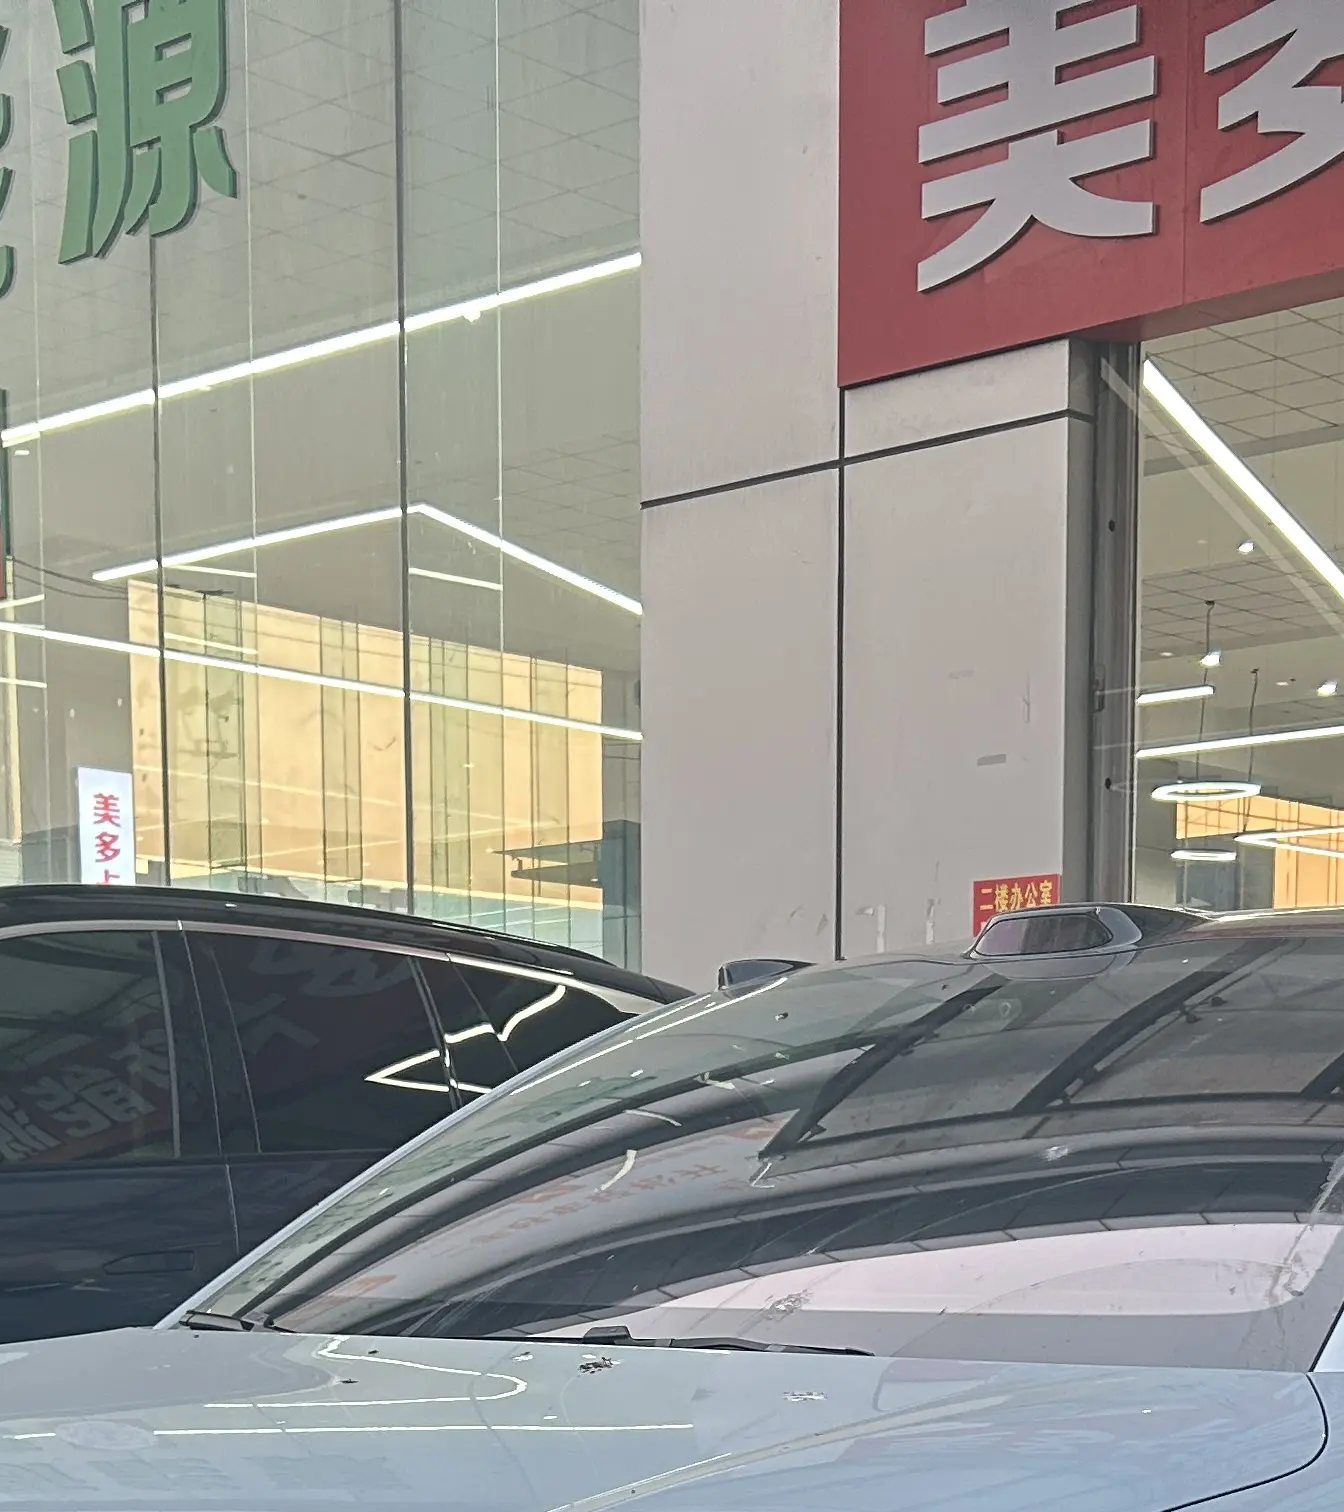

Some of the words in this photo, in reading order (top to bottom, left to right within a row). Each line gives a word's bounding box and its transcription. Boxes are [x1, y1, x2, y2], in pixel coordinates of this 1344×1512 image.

[979, 879, 1053, 913] 二楼办公室
